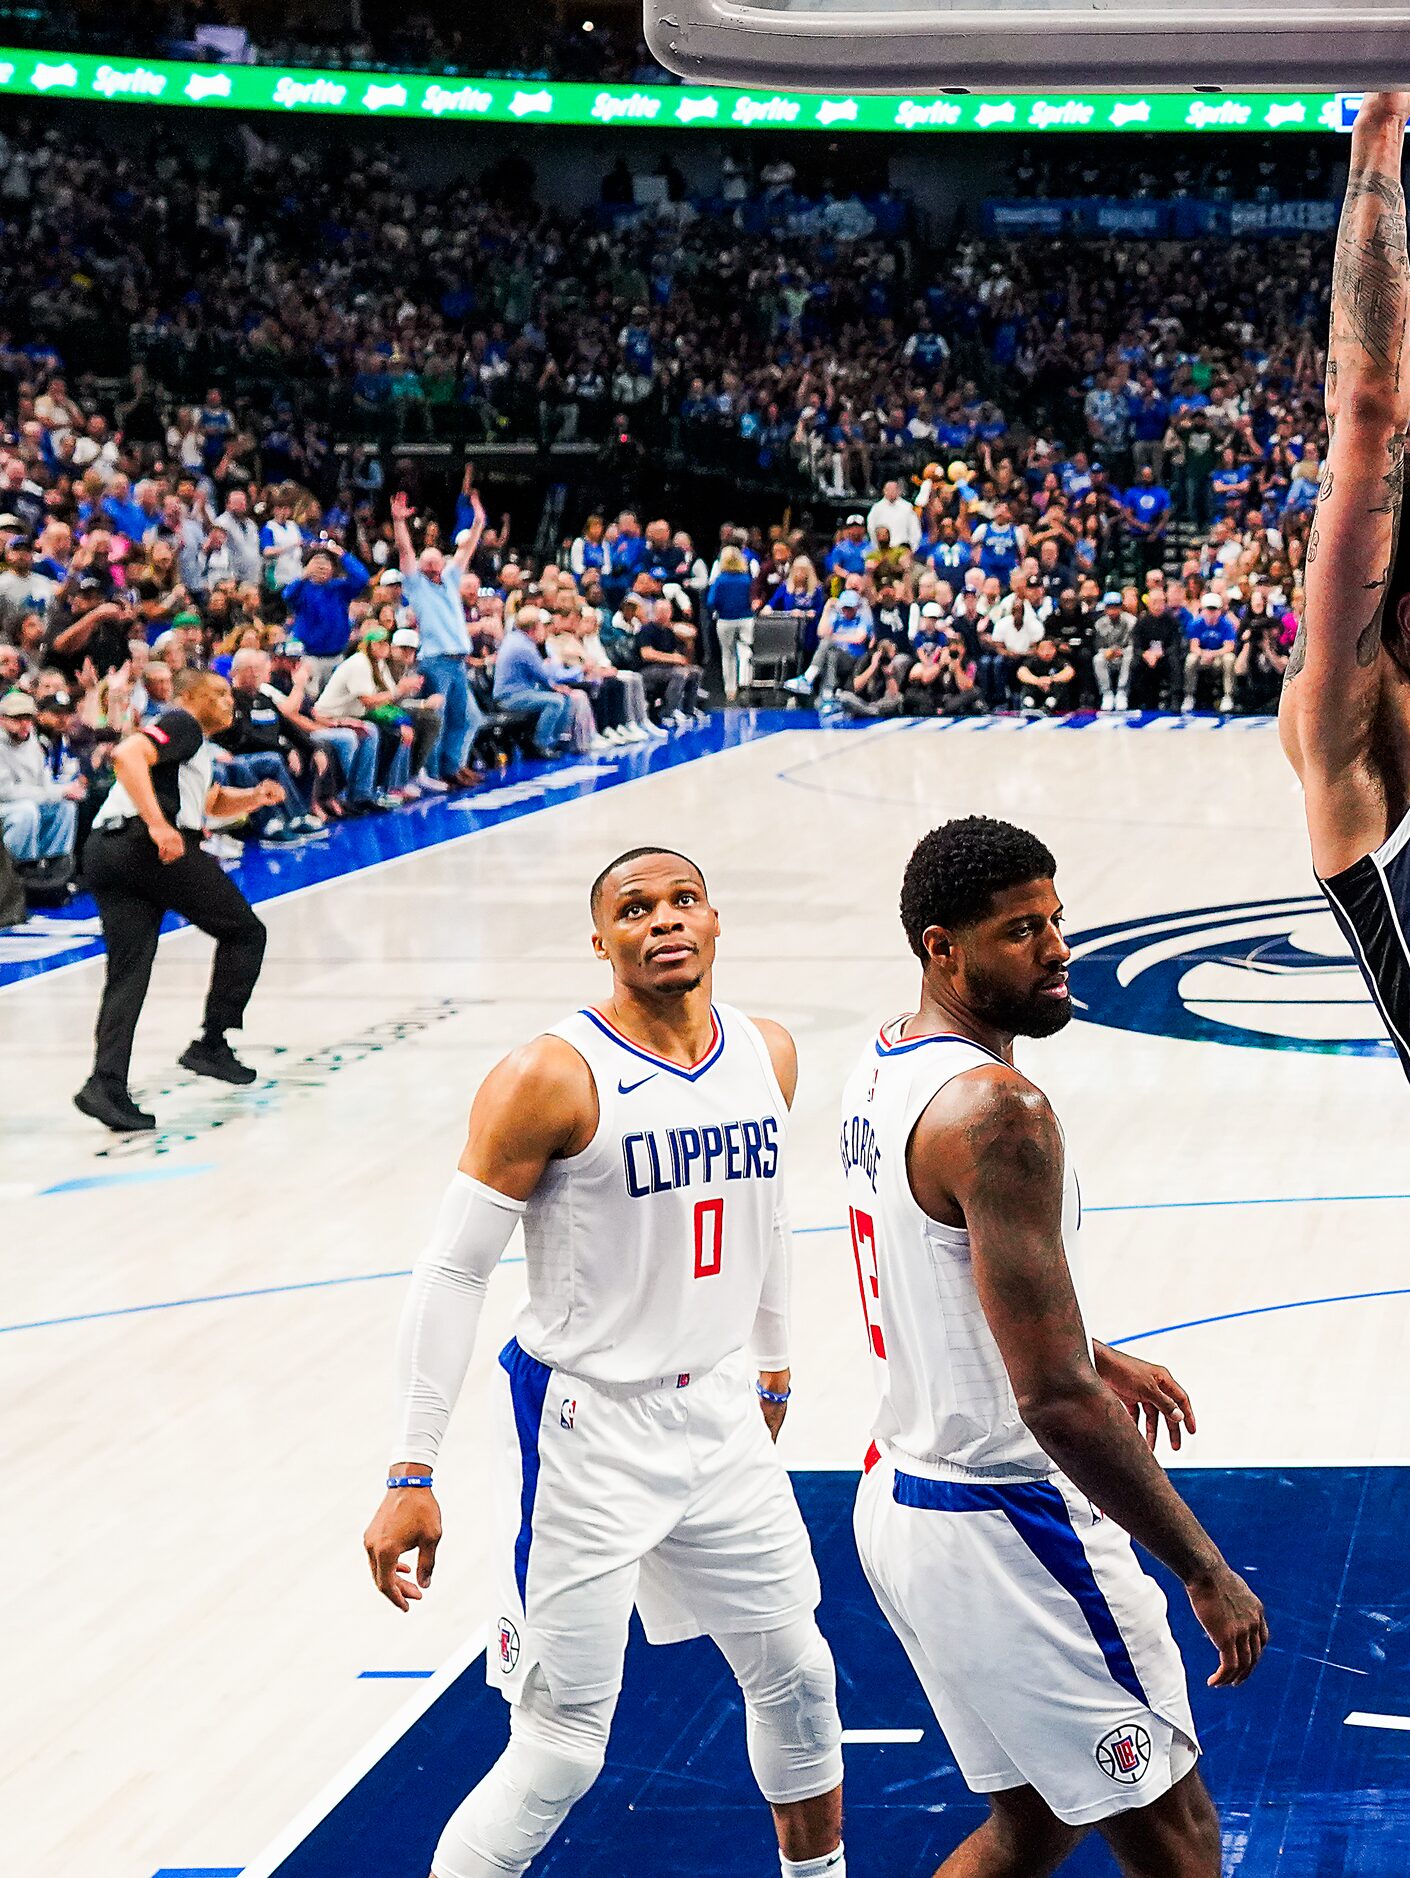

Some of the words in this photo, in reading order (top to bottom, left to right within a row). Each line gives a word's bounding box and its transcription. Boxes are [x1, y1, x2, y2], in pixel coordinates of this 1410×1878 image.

[93, 65, 167, 97] Sprite
[273, 76, 347, 108] Sprite
[421, 85, 493, 115] Sprite
[591, 92, 661, 122] Sprite
[731, 96, 801, 125] Sprite
[894, 100, 962, 129] Sprite
[1028, 101, 1095, 129] Sprite
[1185, 101, 1252, 129] Sprite
[621, 1115, 778, 1199] CLIPPERS
[693, 1197, 724, 1279] 0
